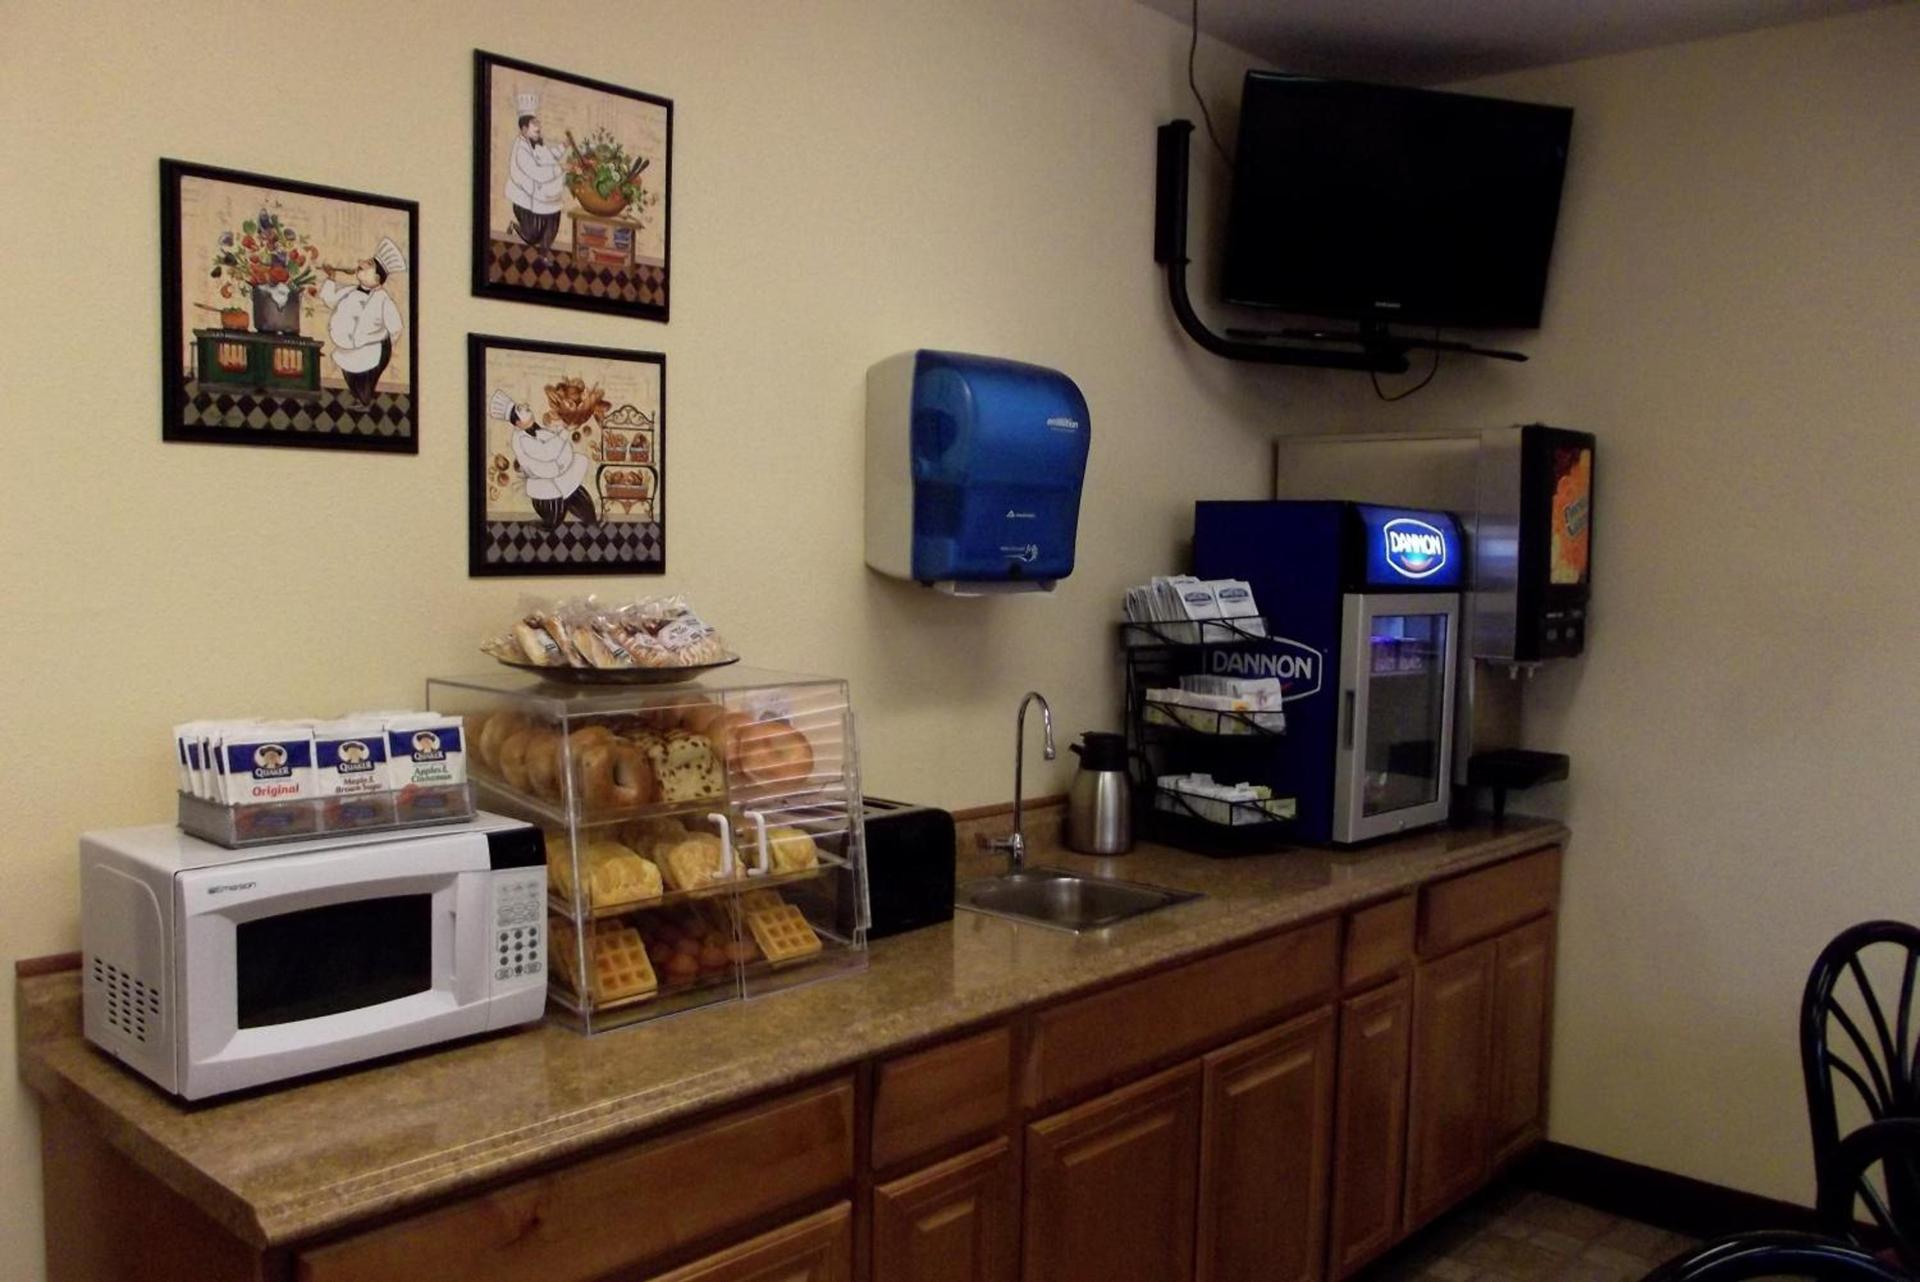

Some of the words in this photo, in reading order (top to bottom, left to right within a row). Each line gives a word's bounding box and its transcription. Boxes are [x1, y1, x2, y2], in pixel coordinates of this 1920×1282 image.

[1389, 531, 1441, 555] DANNON
[1212, 650, 1312, 679] DANNON
[254, 767, 289, 777] QUAKER
[252, 782, 300, 798] Original
